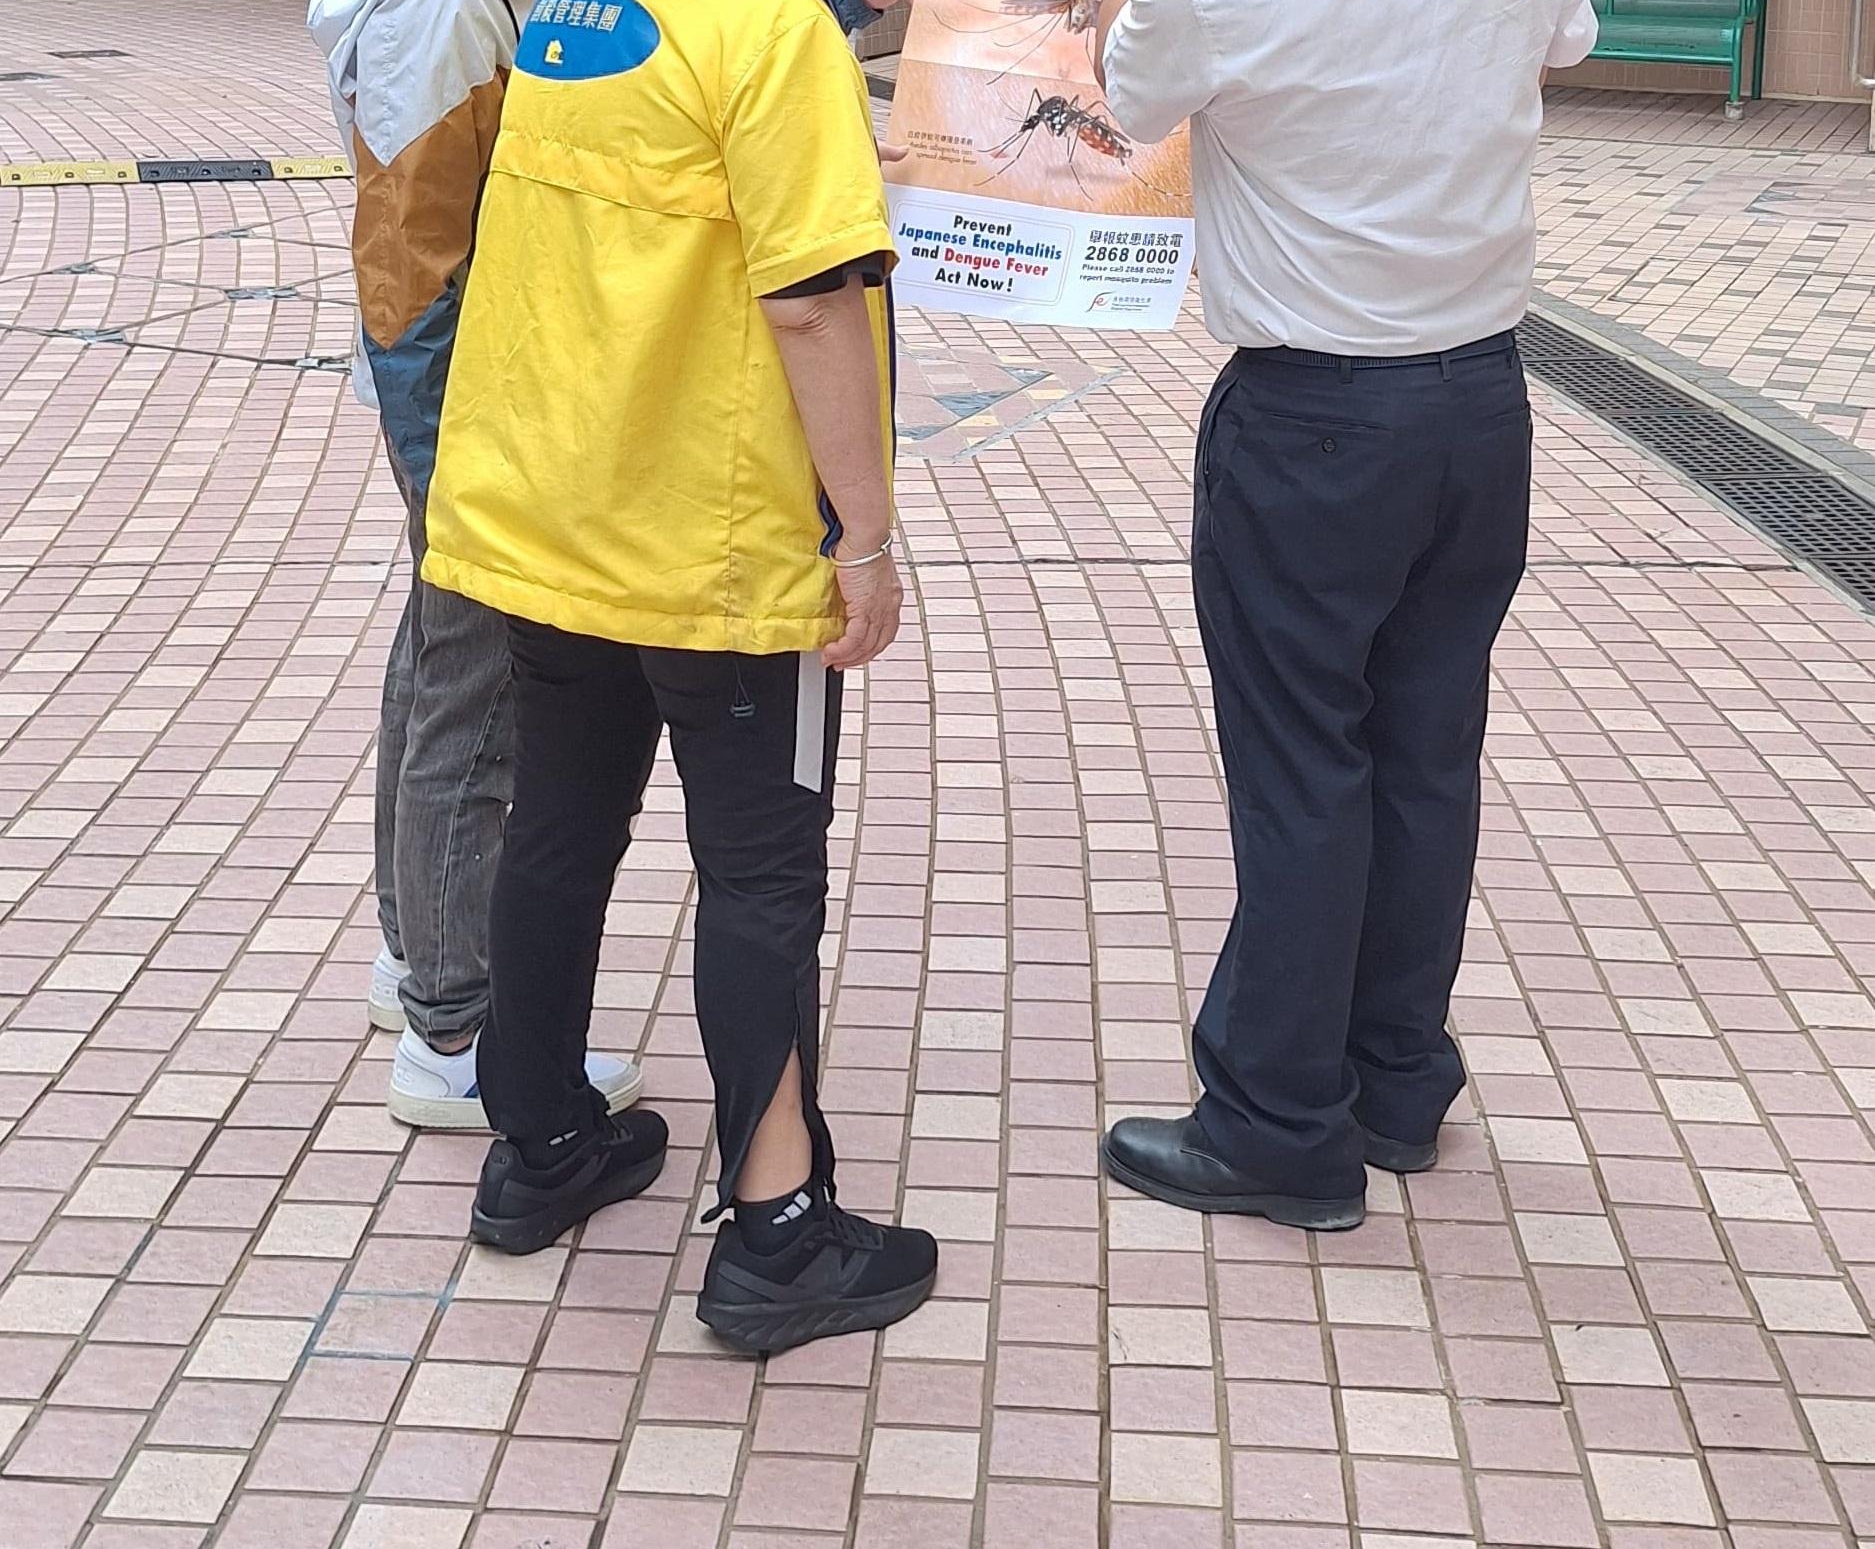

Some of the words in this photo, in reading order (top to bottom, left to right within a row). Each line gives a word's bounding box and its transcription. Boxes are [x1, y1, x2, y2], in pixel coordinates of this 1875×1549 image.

[953, 215, 1012, 236] Prevent
[899, 222, 967, 245] Japanese
[972, 234, 1062, 260] Encephalitis
[911, 245, 940, 259] and
[944, 248, 1001, 270] Dengue
[1006, 257, 1049, 277] Fever
[1084, 245, 1130, 262] 2868
[1135, 248, 1179, 264] 0000
[935, 267, 961, 284] Act
[1082, 263, 1108, 272] Please
